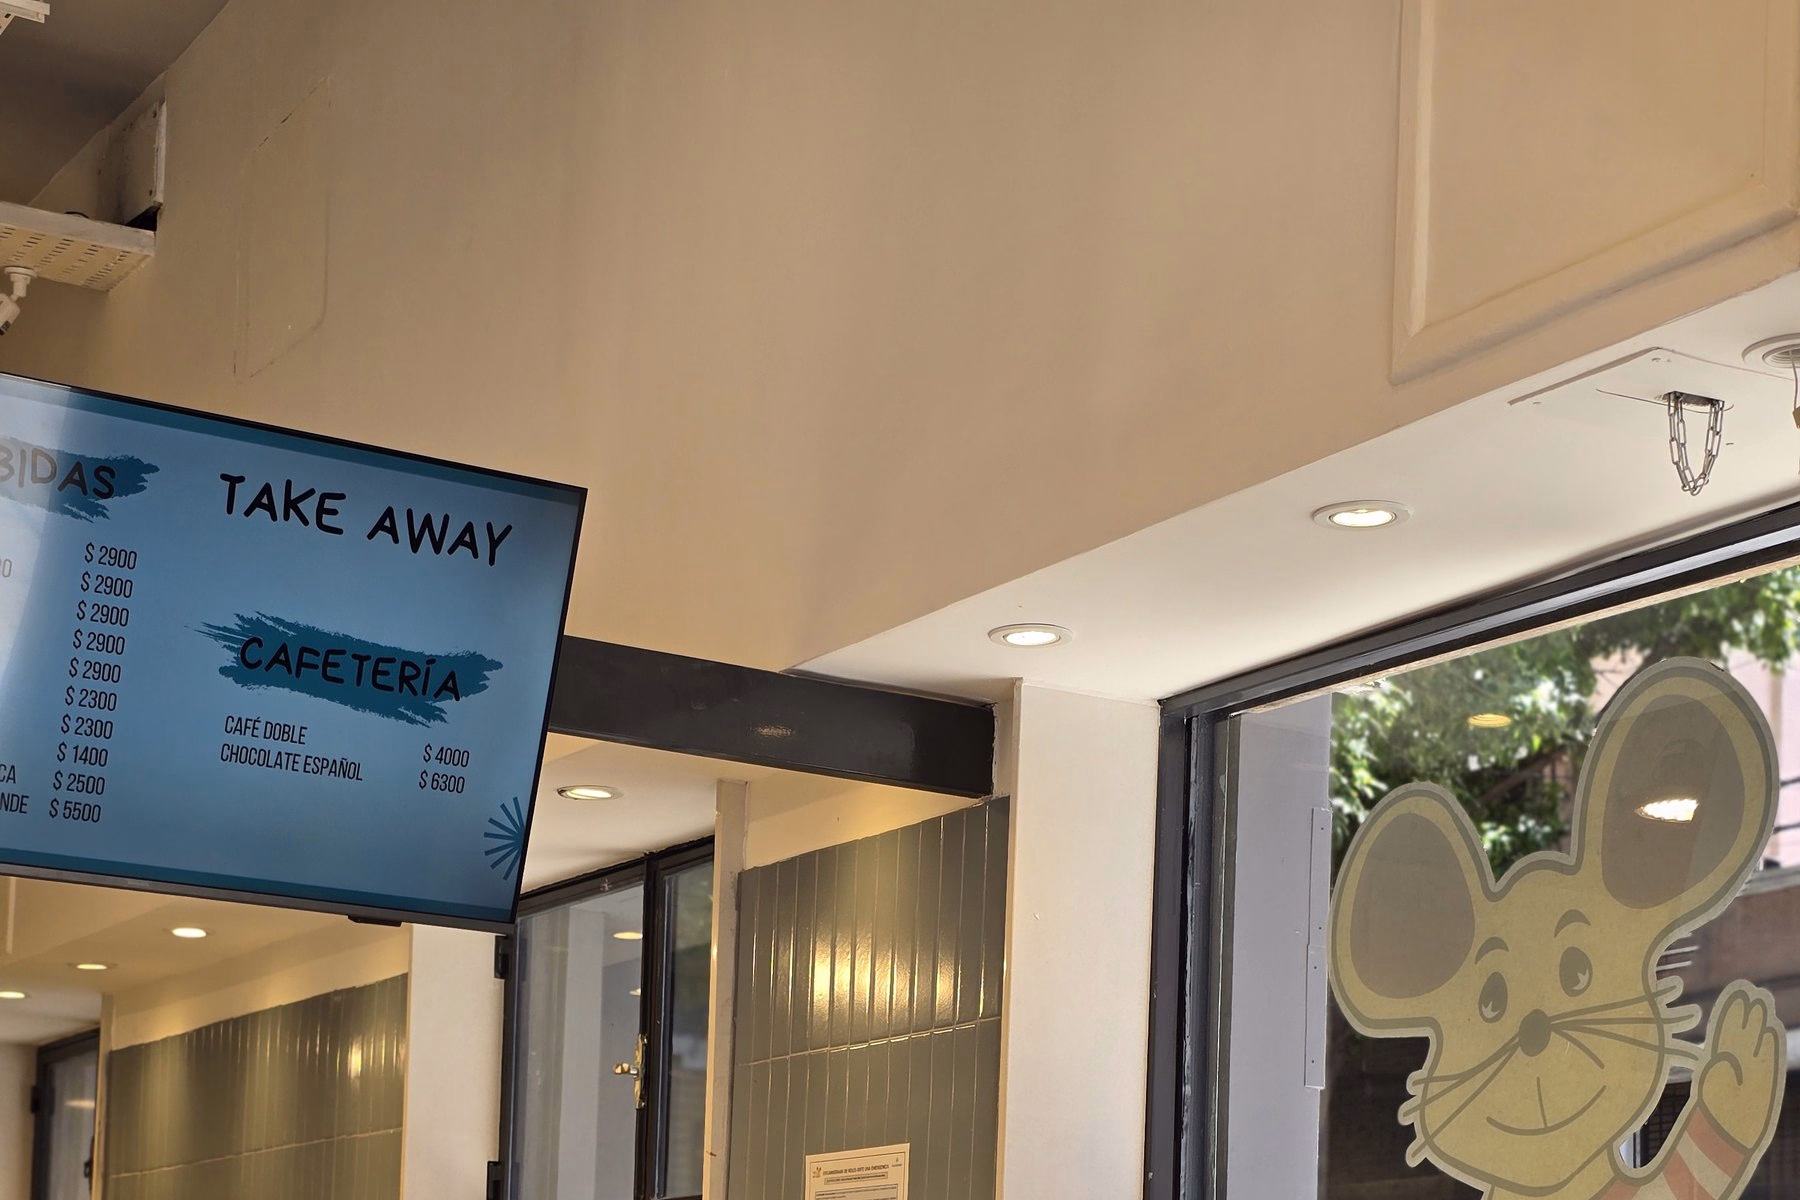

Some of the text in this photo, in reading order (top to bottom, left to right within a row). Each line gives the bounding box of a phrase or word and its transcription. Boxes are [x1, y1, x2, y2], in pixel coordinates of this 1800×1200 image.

[220, 473, 513, 567] TAKE AWAY
[97, 545, 138, 570] 2900
[94, 574, 134, 599] 2900
[90, 603, 130, 627] 2900
[86, 631, 126, 656] 2900
[82, 660, 122, 684] 2900
[239, 636, 462, 702] CAFETERÍA
[78, 688, 118, 712] 2300
[74, 716, 114, 740] 2300
[224, 715, 308, 745] CAFÉ DOBLE
[72, 745, 109, 768] 1400
[220, 743, 363, 782] CHOCOLATE ESPAÑOL
[435, 747, 470, 768] 4000
[66, 772, 106, 796] 2500
[430, 773, 466, 794] 6300
[62, 800, 102, 824] 5500
